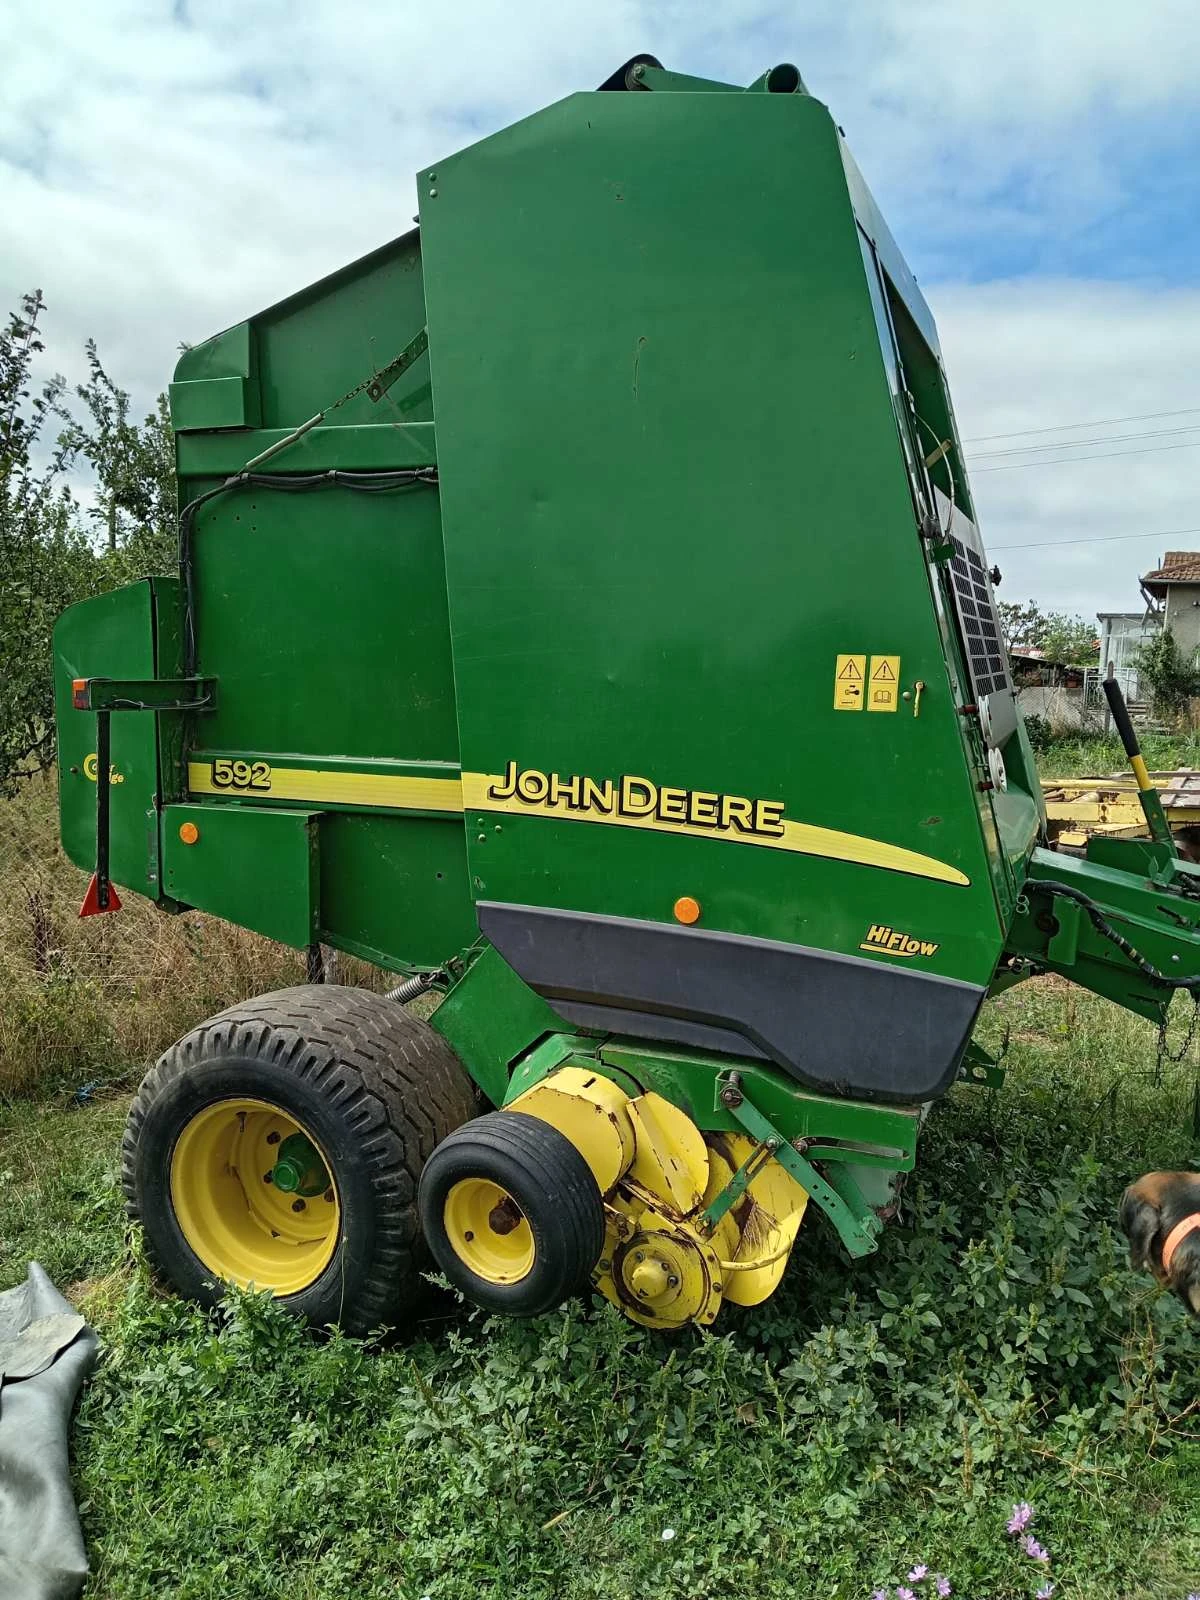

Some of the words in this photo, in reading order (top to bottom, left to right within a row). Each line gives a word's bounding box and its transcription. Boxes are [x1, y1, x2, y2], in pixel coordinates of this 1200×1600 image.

[211, 759, 272, 791] 592
[489, 760, 613, 816] JOHN
[618, 774, 785, 838] DEERE
[865, 924, 940, 957] HiFlow
